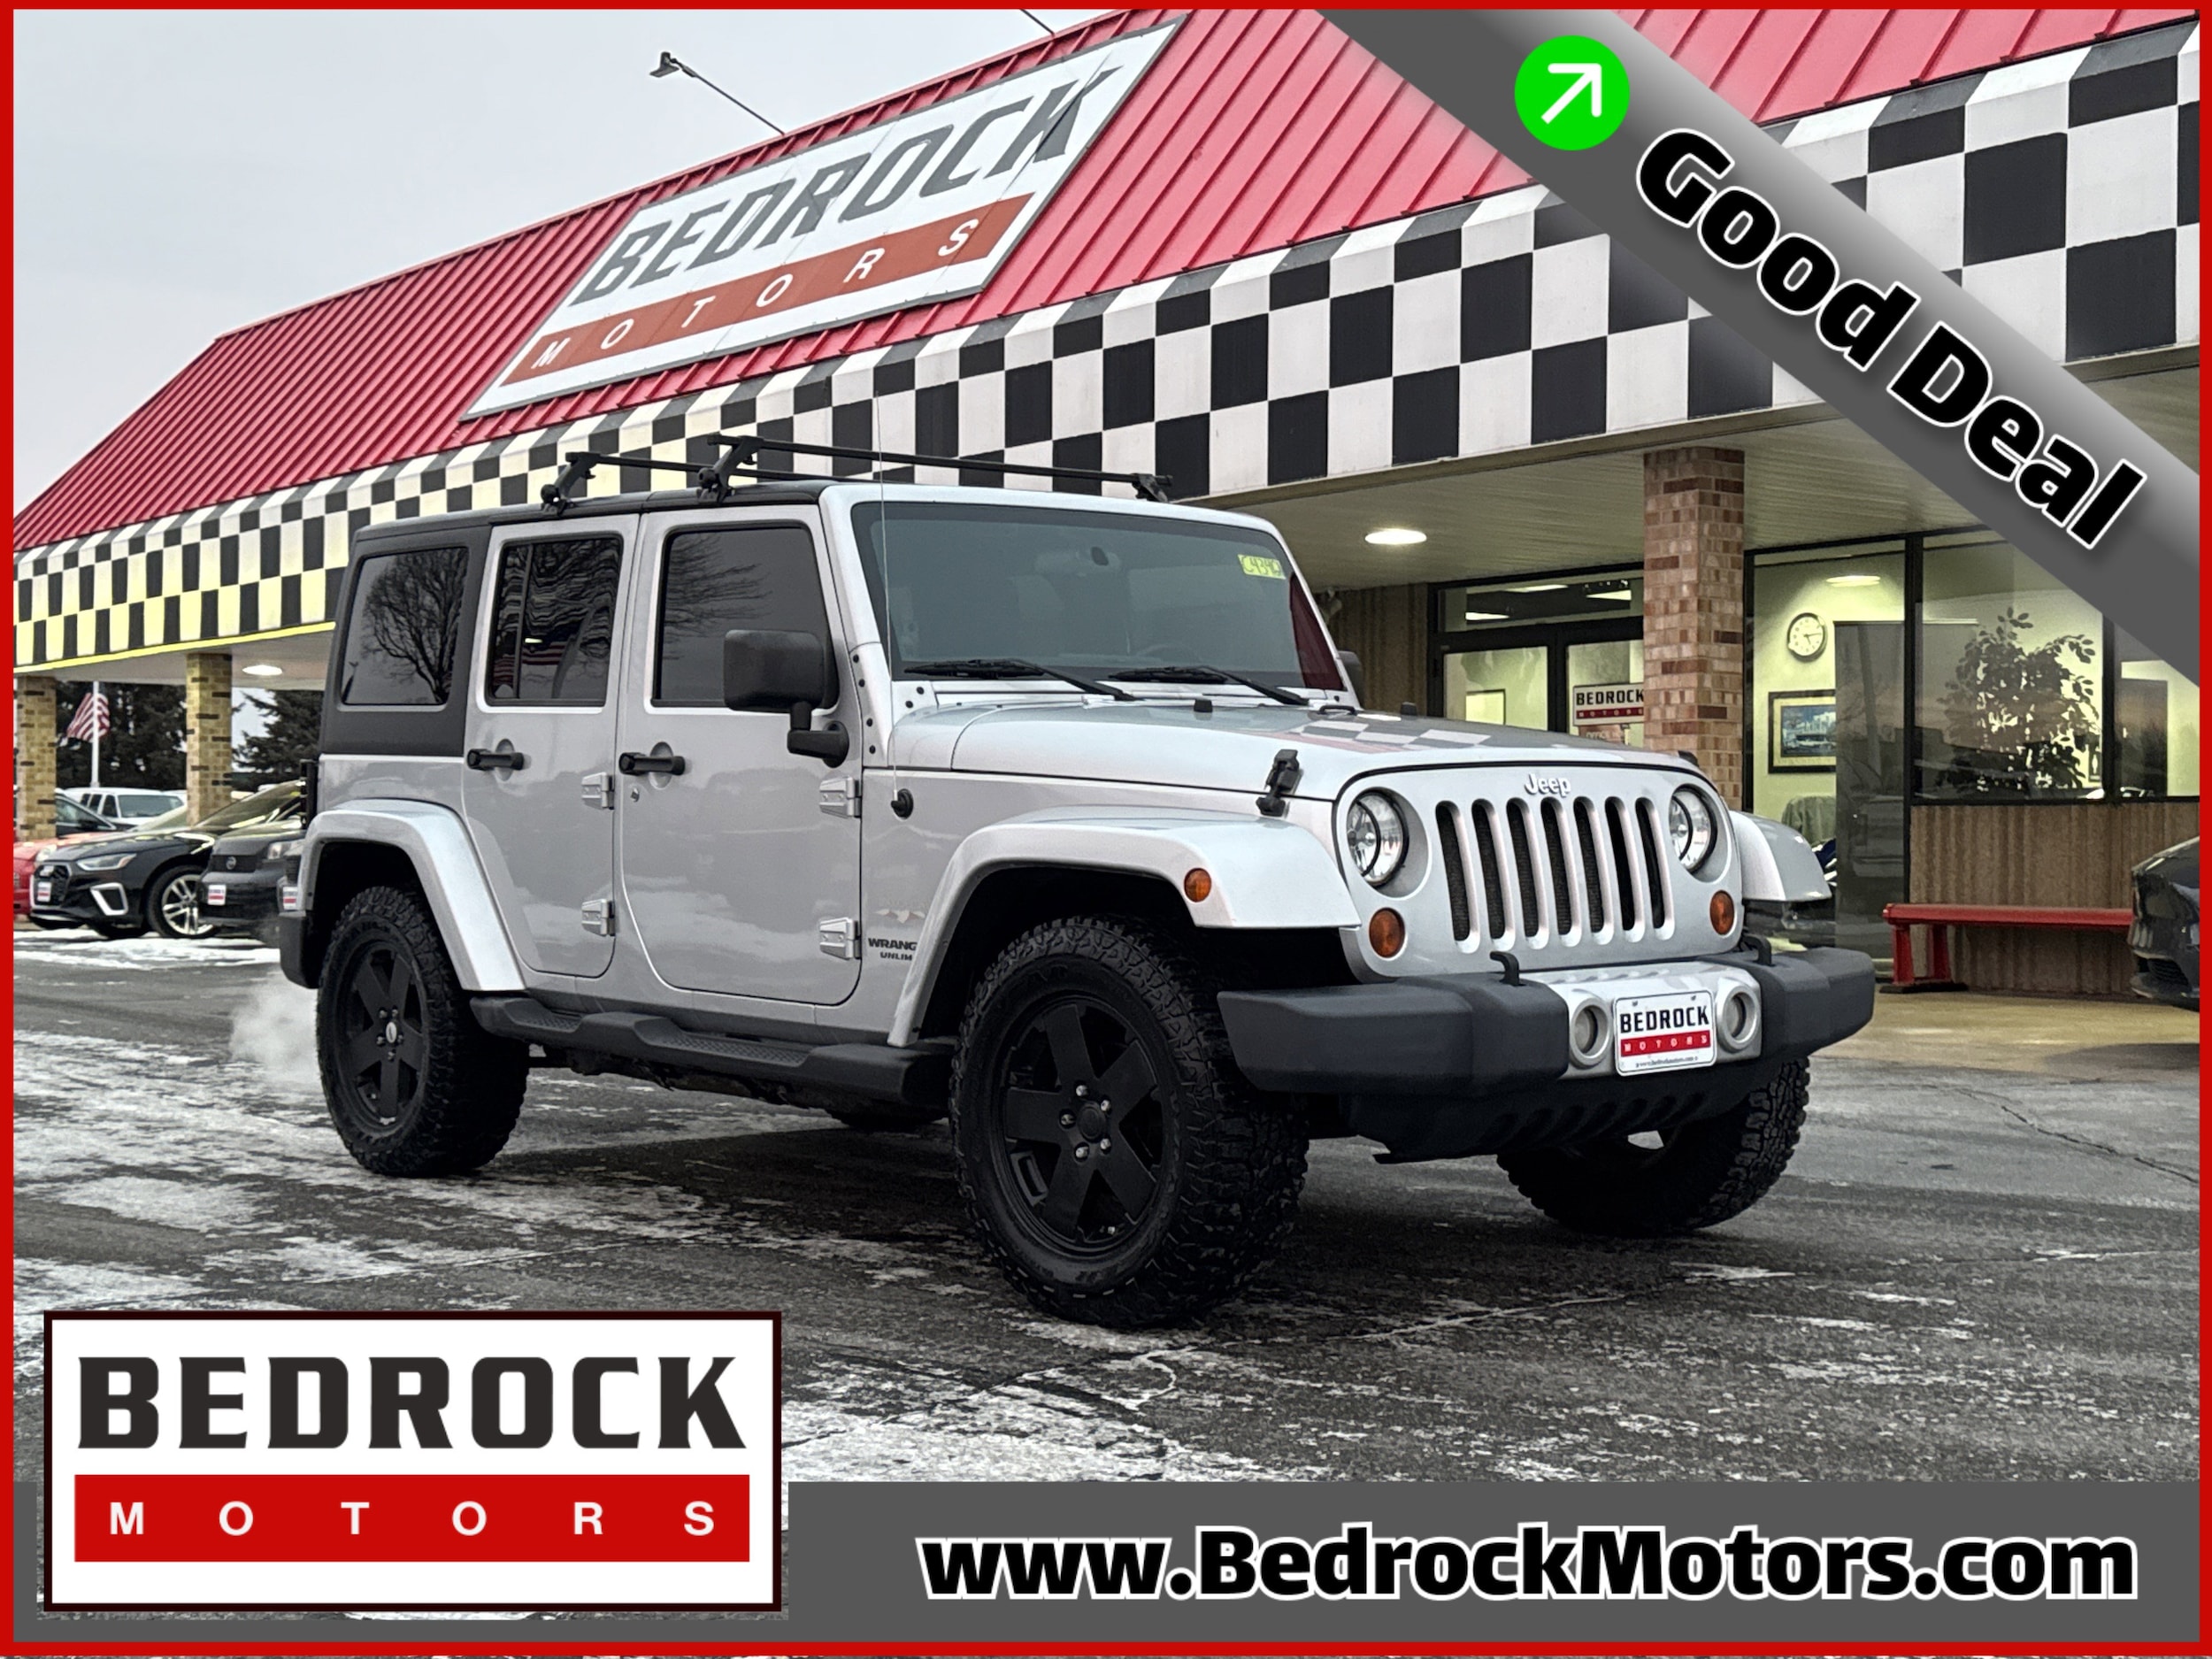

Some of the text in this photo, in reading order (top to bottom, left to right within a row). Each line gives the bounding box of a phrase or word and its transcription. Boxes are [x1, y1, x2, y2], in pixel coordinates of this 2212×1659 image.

[570, 65, 1125, 306] BEDROCK
[531, 218, 979, 370] MOTORS
[1576, 688, 1644, 705] BEDROCK
[1525, 773, 1571, 797] Jeep
[1619, 1005, 1709, 1033] BEDROCK
[1624, 1034, 1708, 1052] MOTORS
